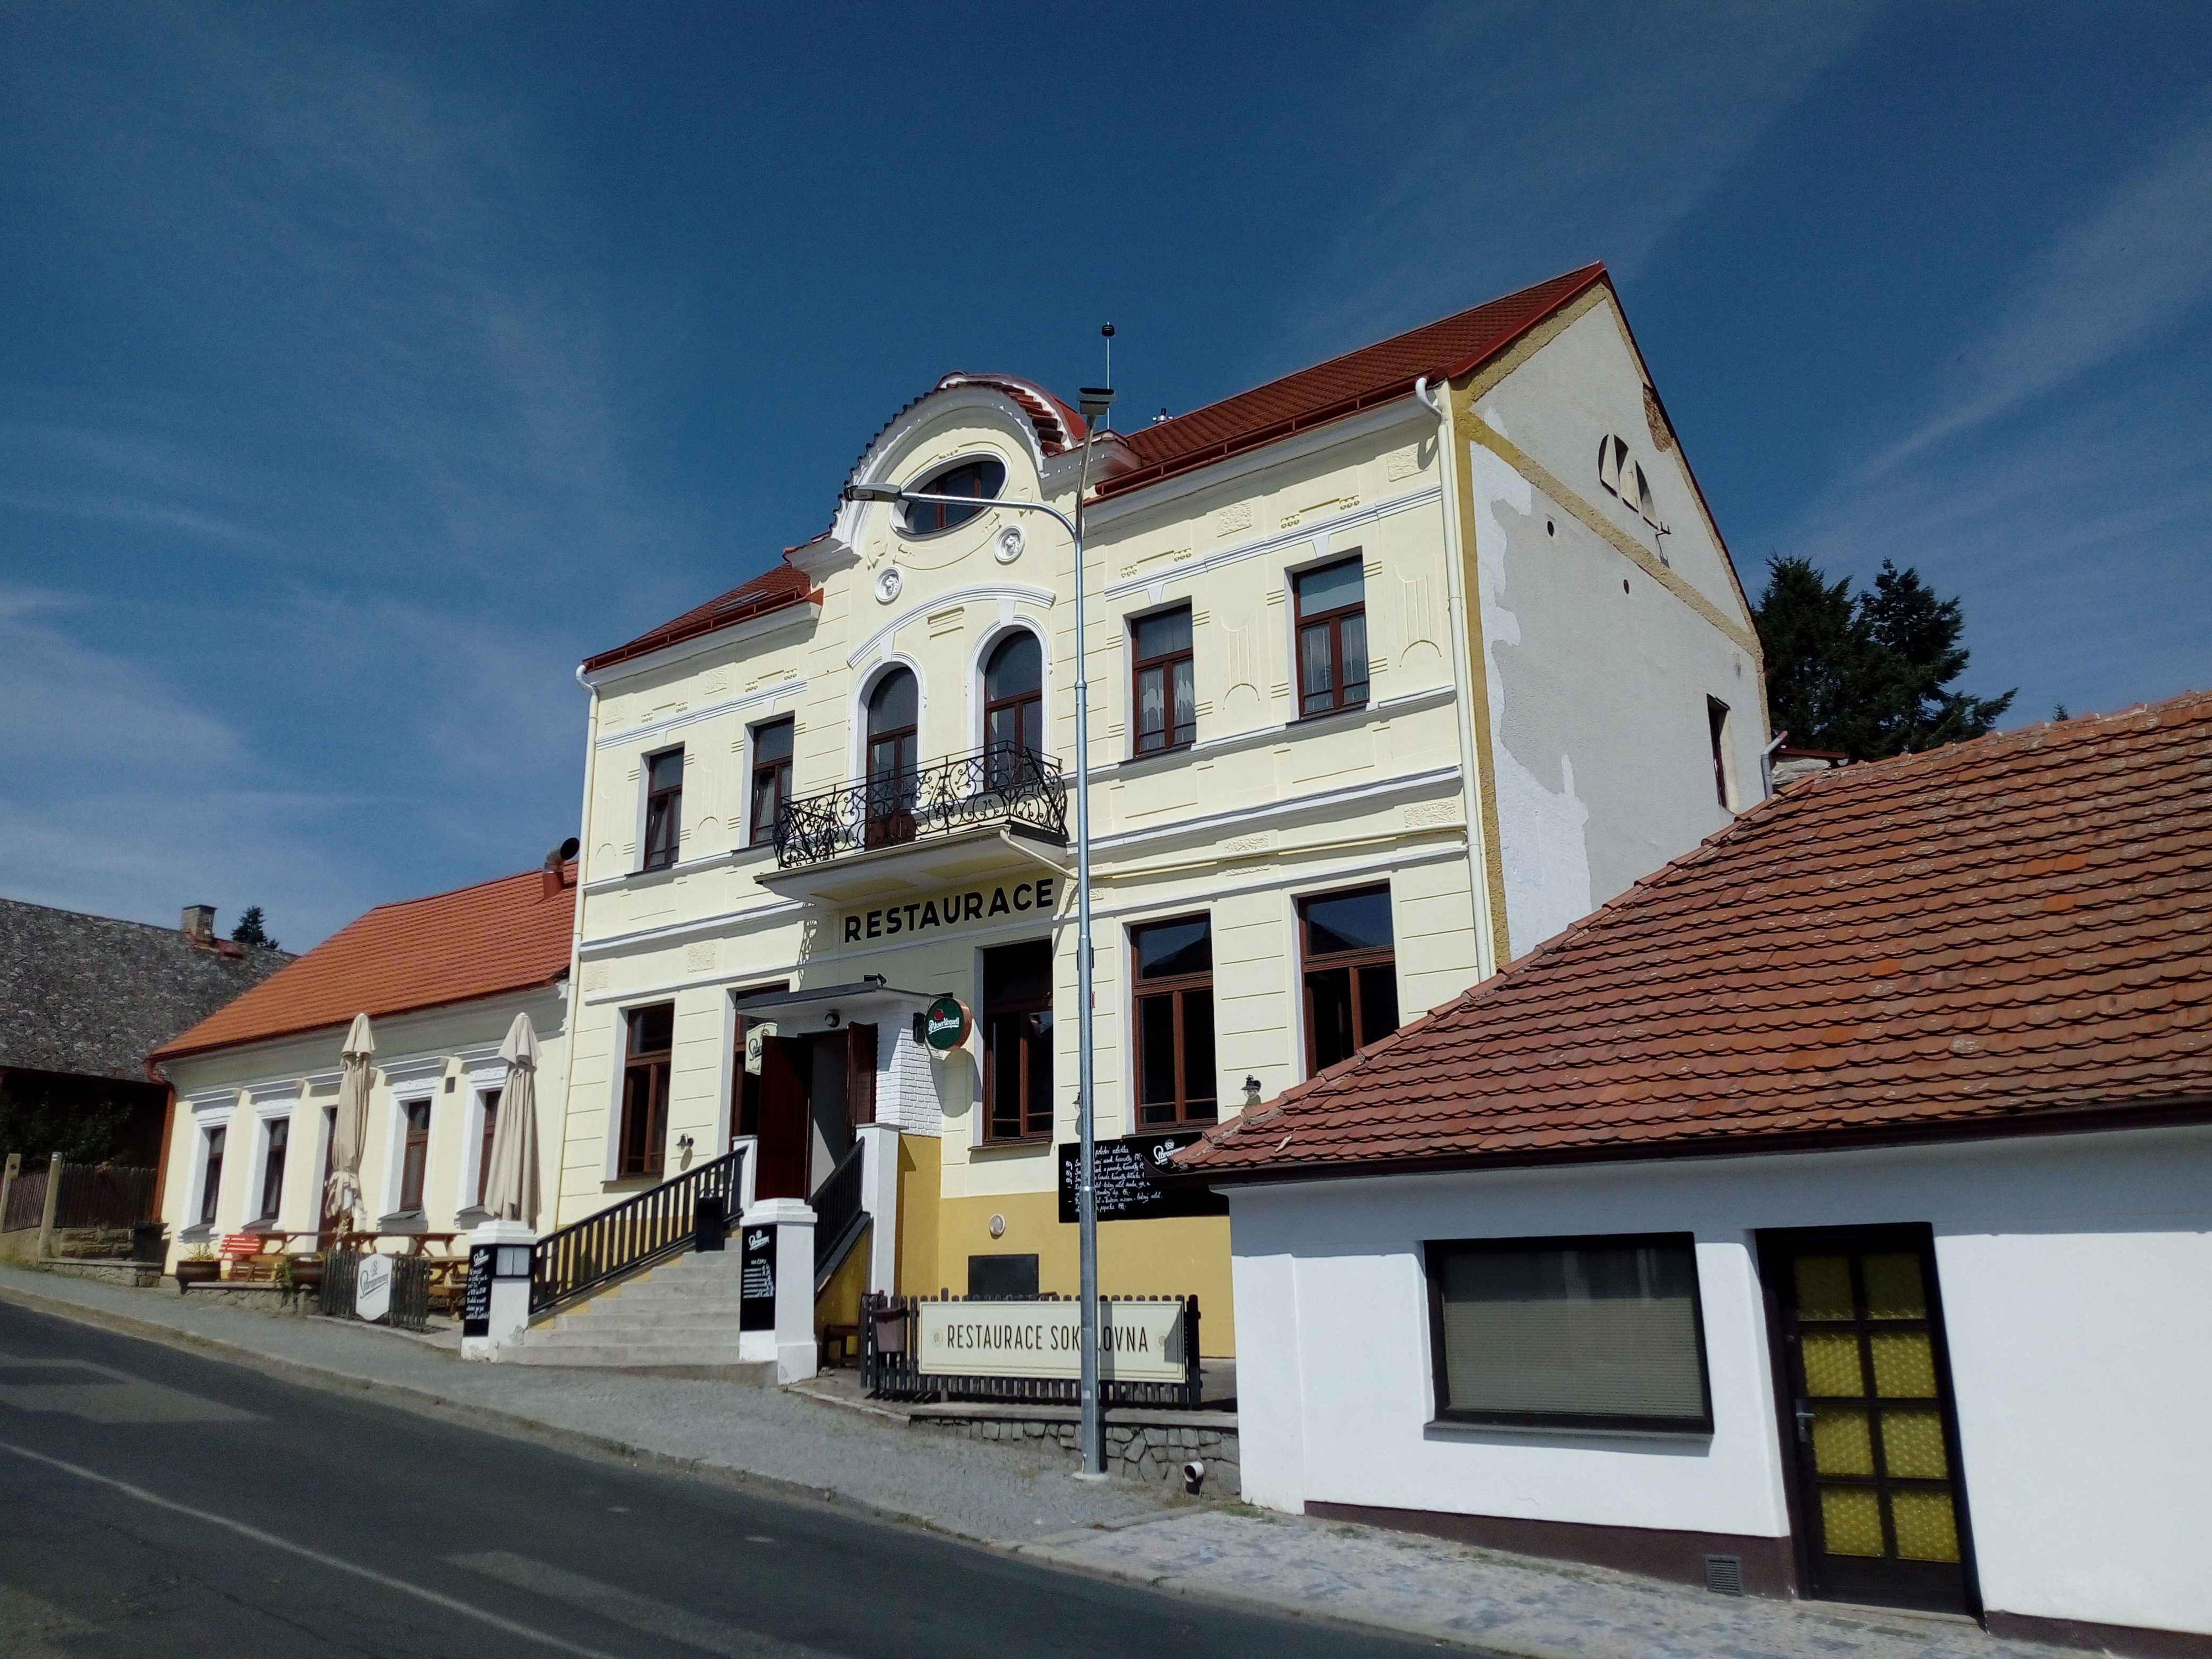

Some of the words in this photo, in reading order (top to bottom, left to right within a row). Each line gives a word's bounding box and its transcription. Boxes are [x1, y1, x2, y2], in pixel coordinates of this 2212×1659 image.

[845, 878, 1053, 943] RESTAURACE
[947, 1324, 1043, 1350] RESTAURACE
[1050, 1325, 1149, 1353] SOKOVNA
